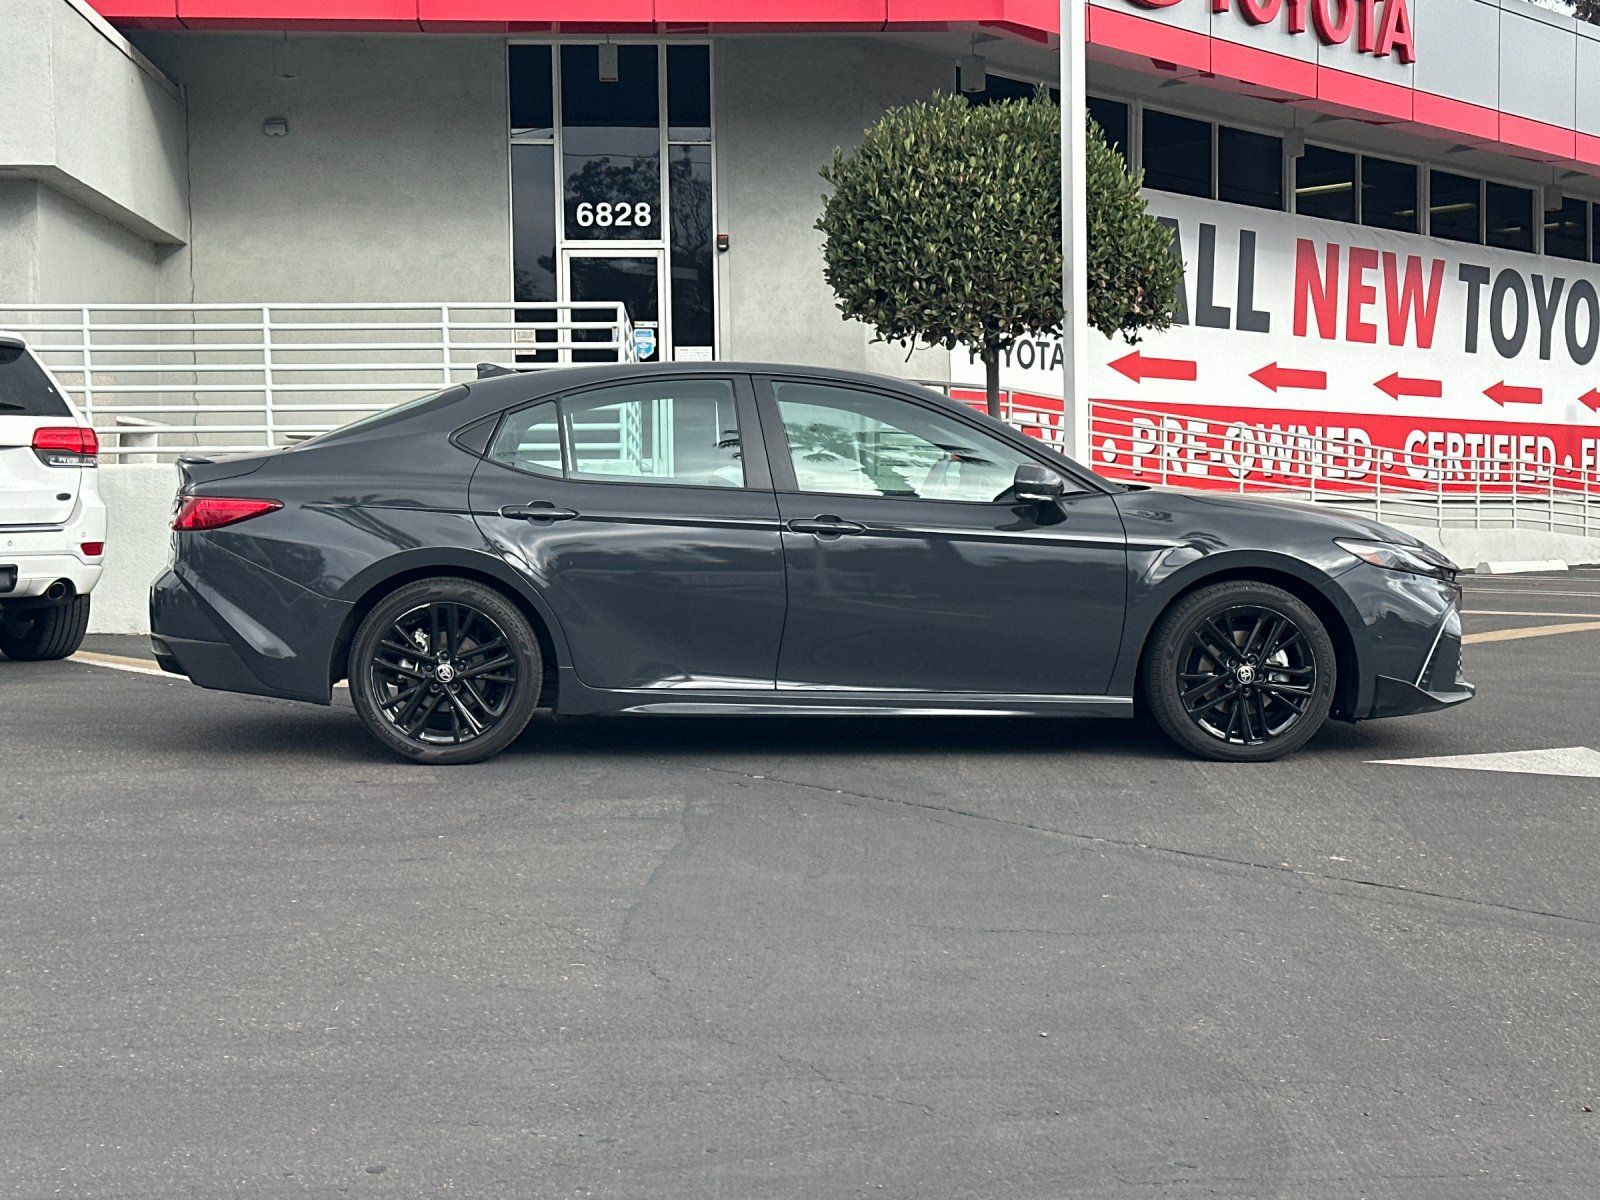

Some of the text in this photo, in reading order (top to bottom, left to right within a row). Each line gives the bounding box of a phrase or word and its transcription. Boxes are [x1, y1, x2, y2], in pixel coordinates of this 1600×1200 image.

[1213, 0, 1415, 63] YOTA
[576, 203, 651, 226] 6828
[1293, 238, 1445, 348] NEW
[1459, 263, 1600, 365] TOYO
[969, 338, 1064, 371] YOTA
[1132, 418, 1372, 479] PRE-OWNED
[1404, 430, 1557, 482] CERTIFIED
